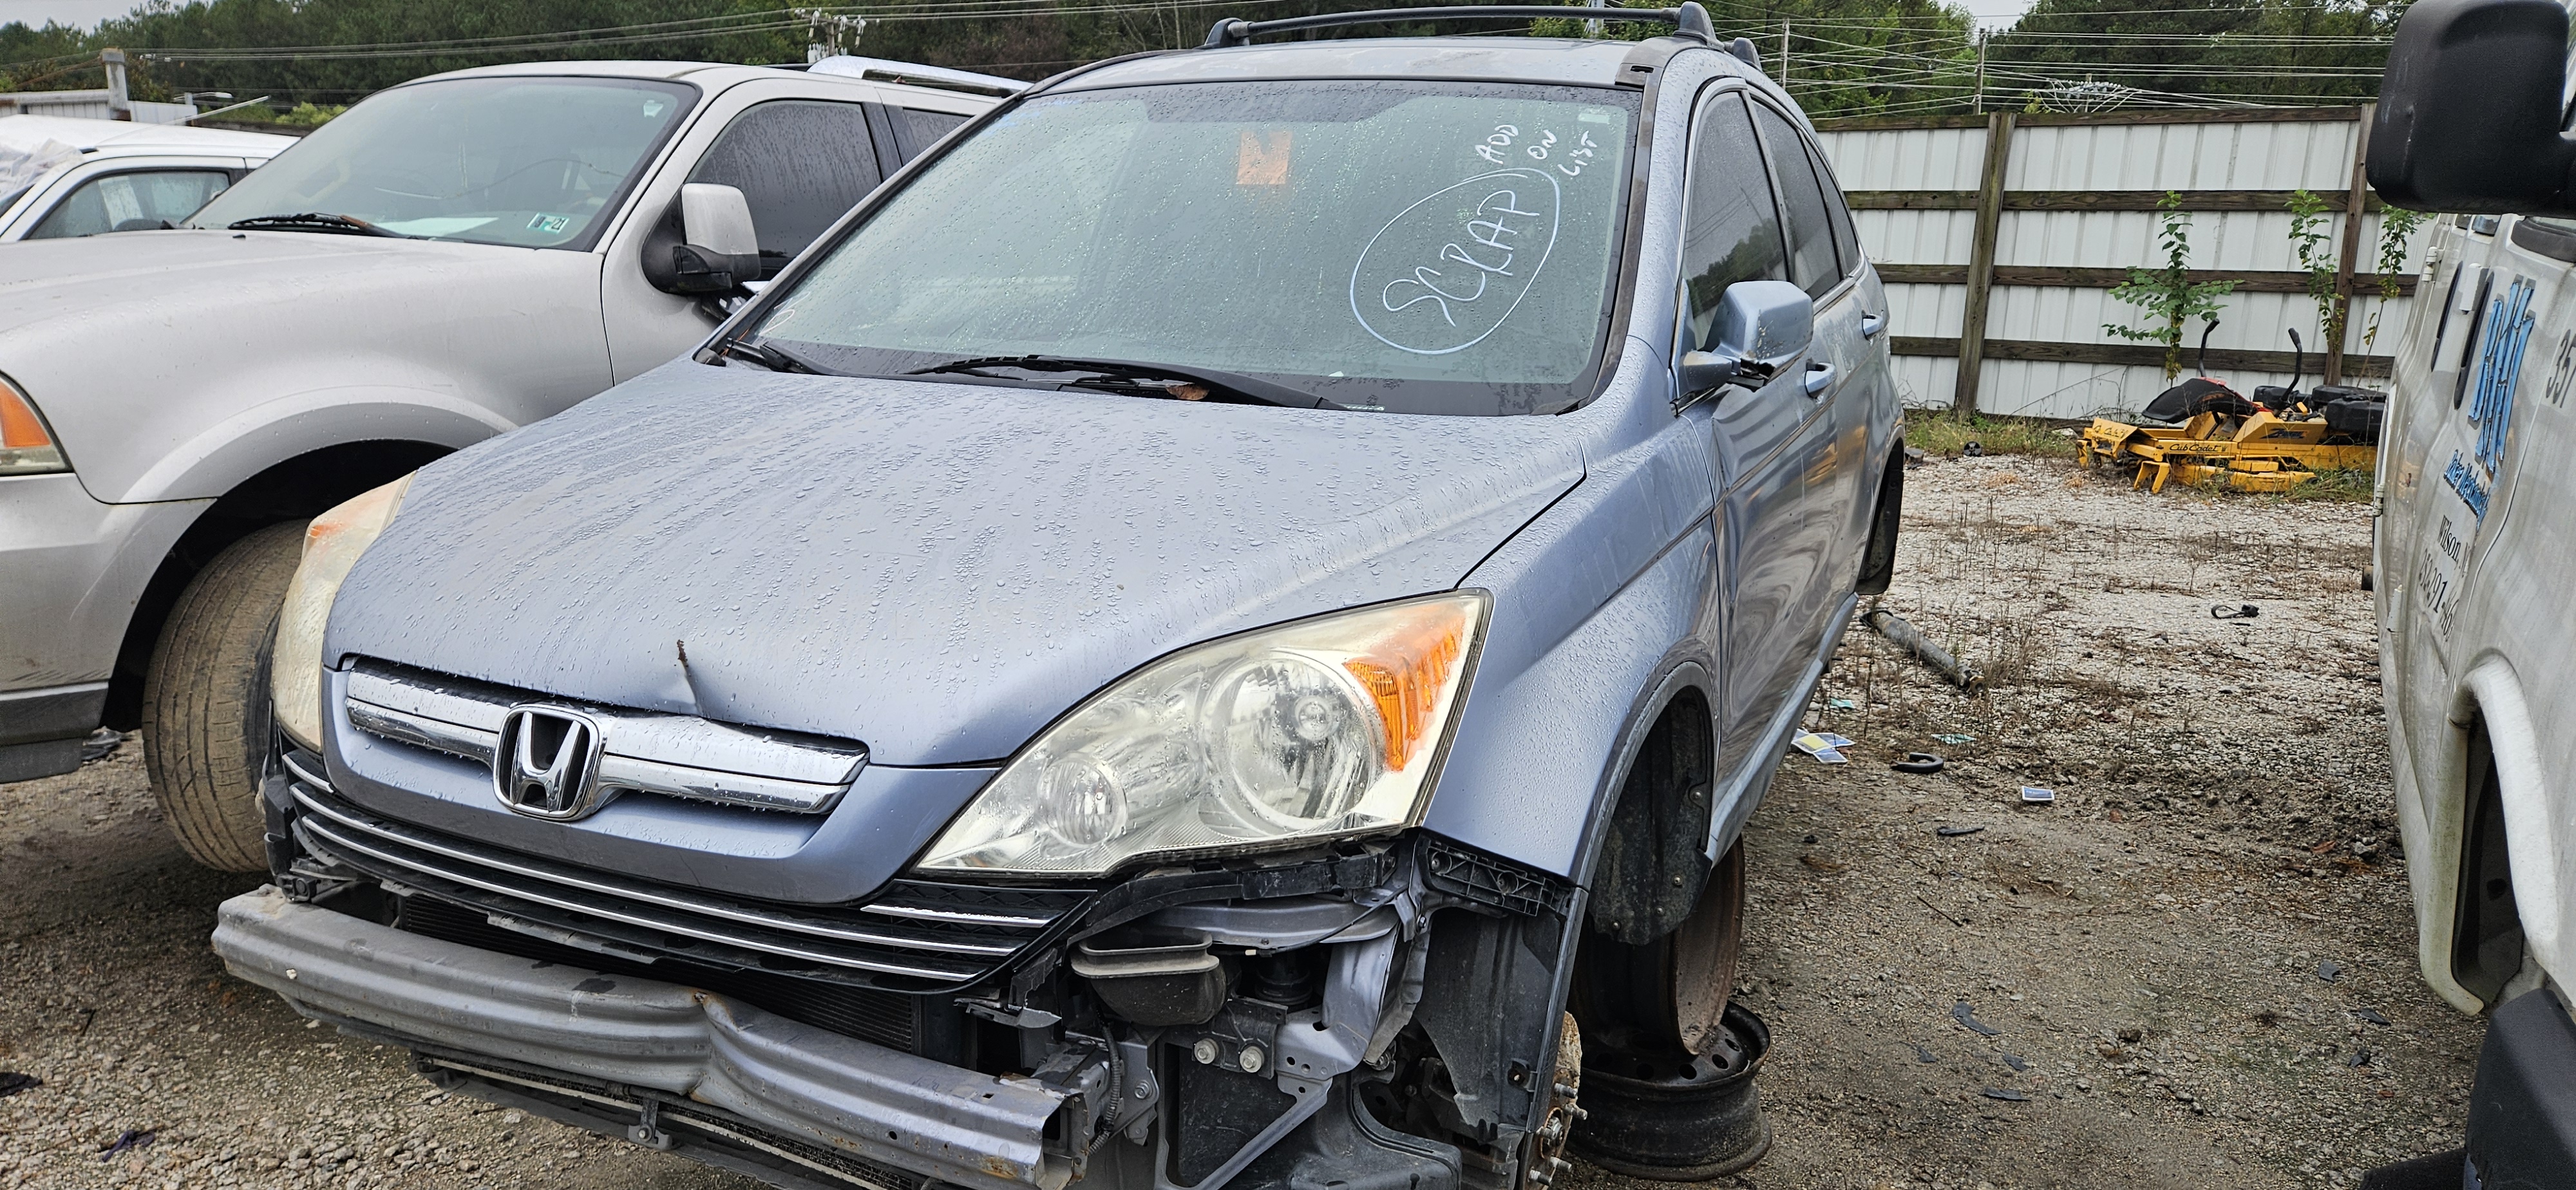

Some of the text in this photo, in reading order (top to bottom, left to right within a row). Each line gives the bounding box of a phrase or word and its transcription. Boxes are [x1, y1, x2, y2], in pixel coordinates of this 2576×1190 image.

[1527, 129, 1557, 160] ON
[1383, 190, 1540, 327] SCRAP
[2169, 443, 2222, 452] Cub Cadet
